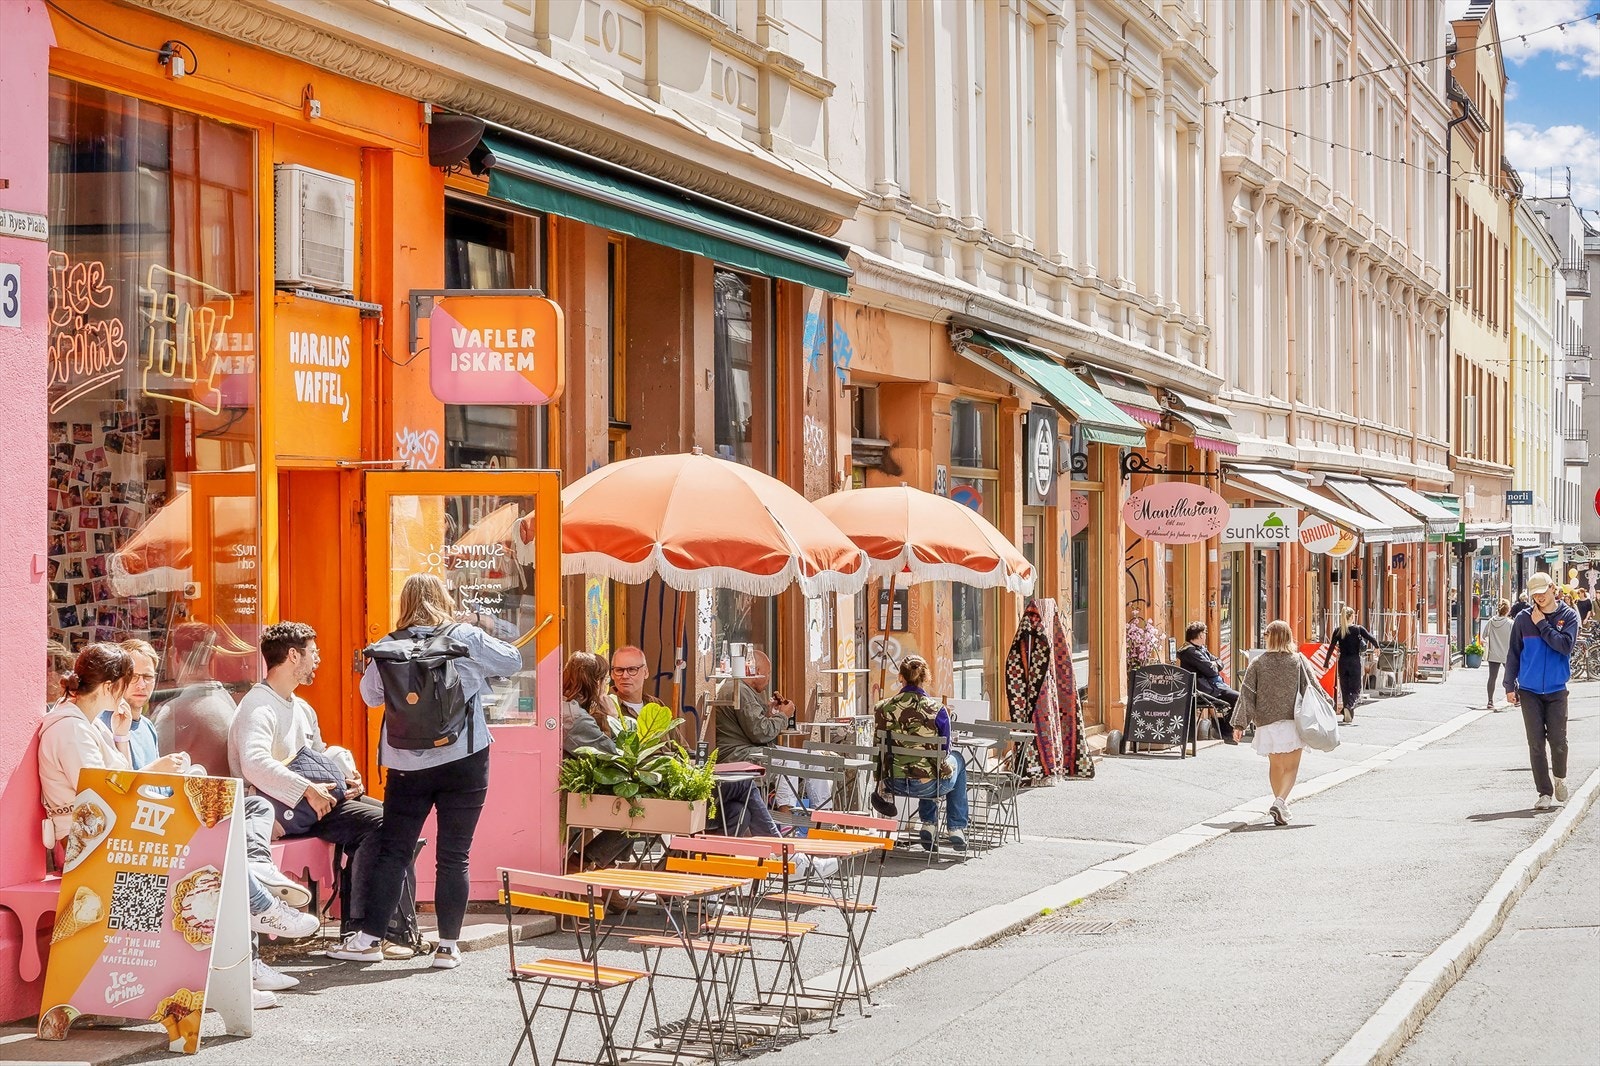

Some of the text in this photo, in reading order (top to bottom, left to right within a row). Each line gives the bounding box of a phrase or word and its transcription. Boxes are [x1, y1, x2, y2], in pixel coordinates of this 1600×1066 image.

[9, 214, 26, 232] Ryes
[3, 273, 18, 318] 3
[451, 328, 536, 349] VAFLER
[289, 332, 350, 368] HARALDS
[451, 352, 535, 372] ISKREM
[294, 371, 343, 406] VAFFEL
[937, 468, 947, 491] 38
[1508, 492, 1529, 500] norli
[1134, 498, 1219, 521] Manillusion
[1226, 524, 1290, 539] sunkost
[106, 838, 190, 857] FEEL FREE TO
[106, 851, 186, 870] ORDER HERE
[103, 934, 161, 949] SKIP THE LINE
[102, 955, 157, 967] VAFFELCOINS!
[109, 971, 138, 988] Ice
[104, 981, 146, 1004] Crime
